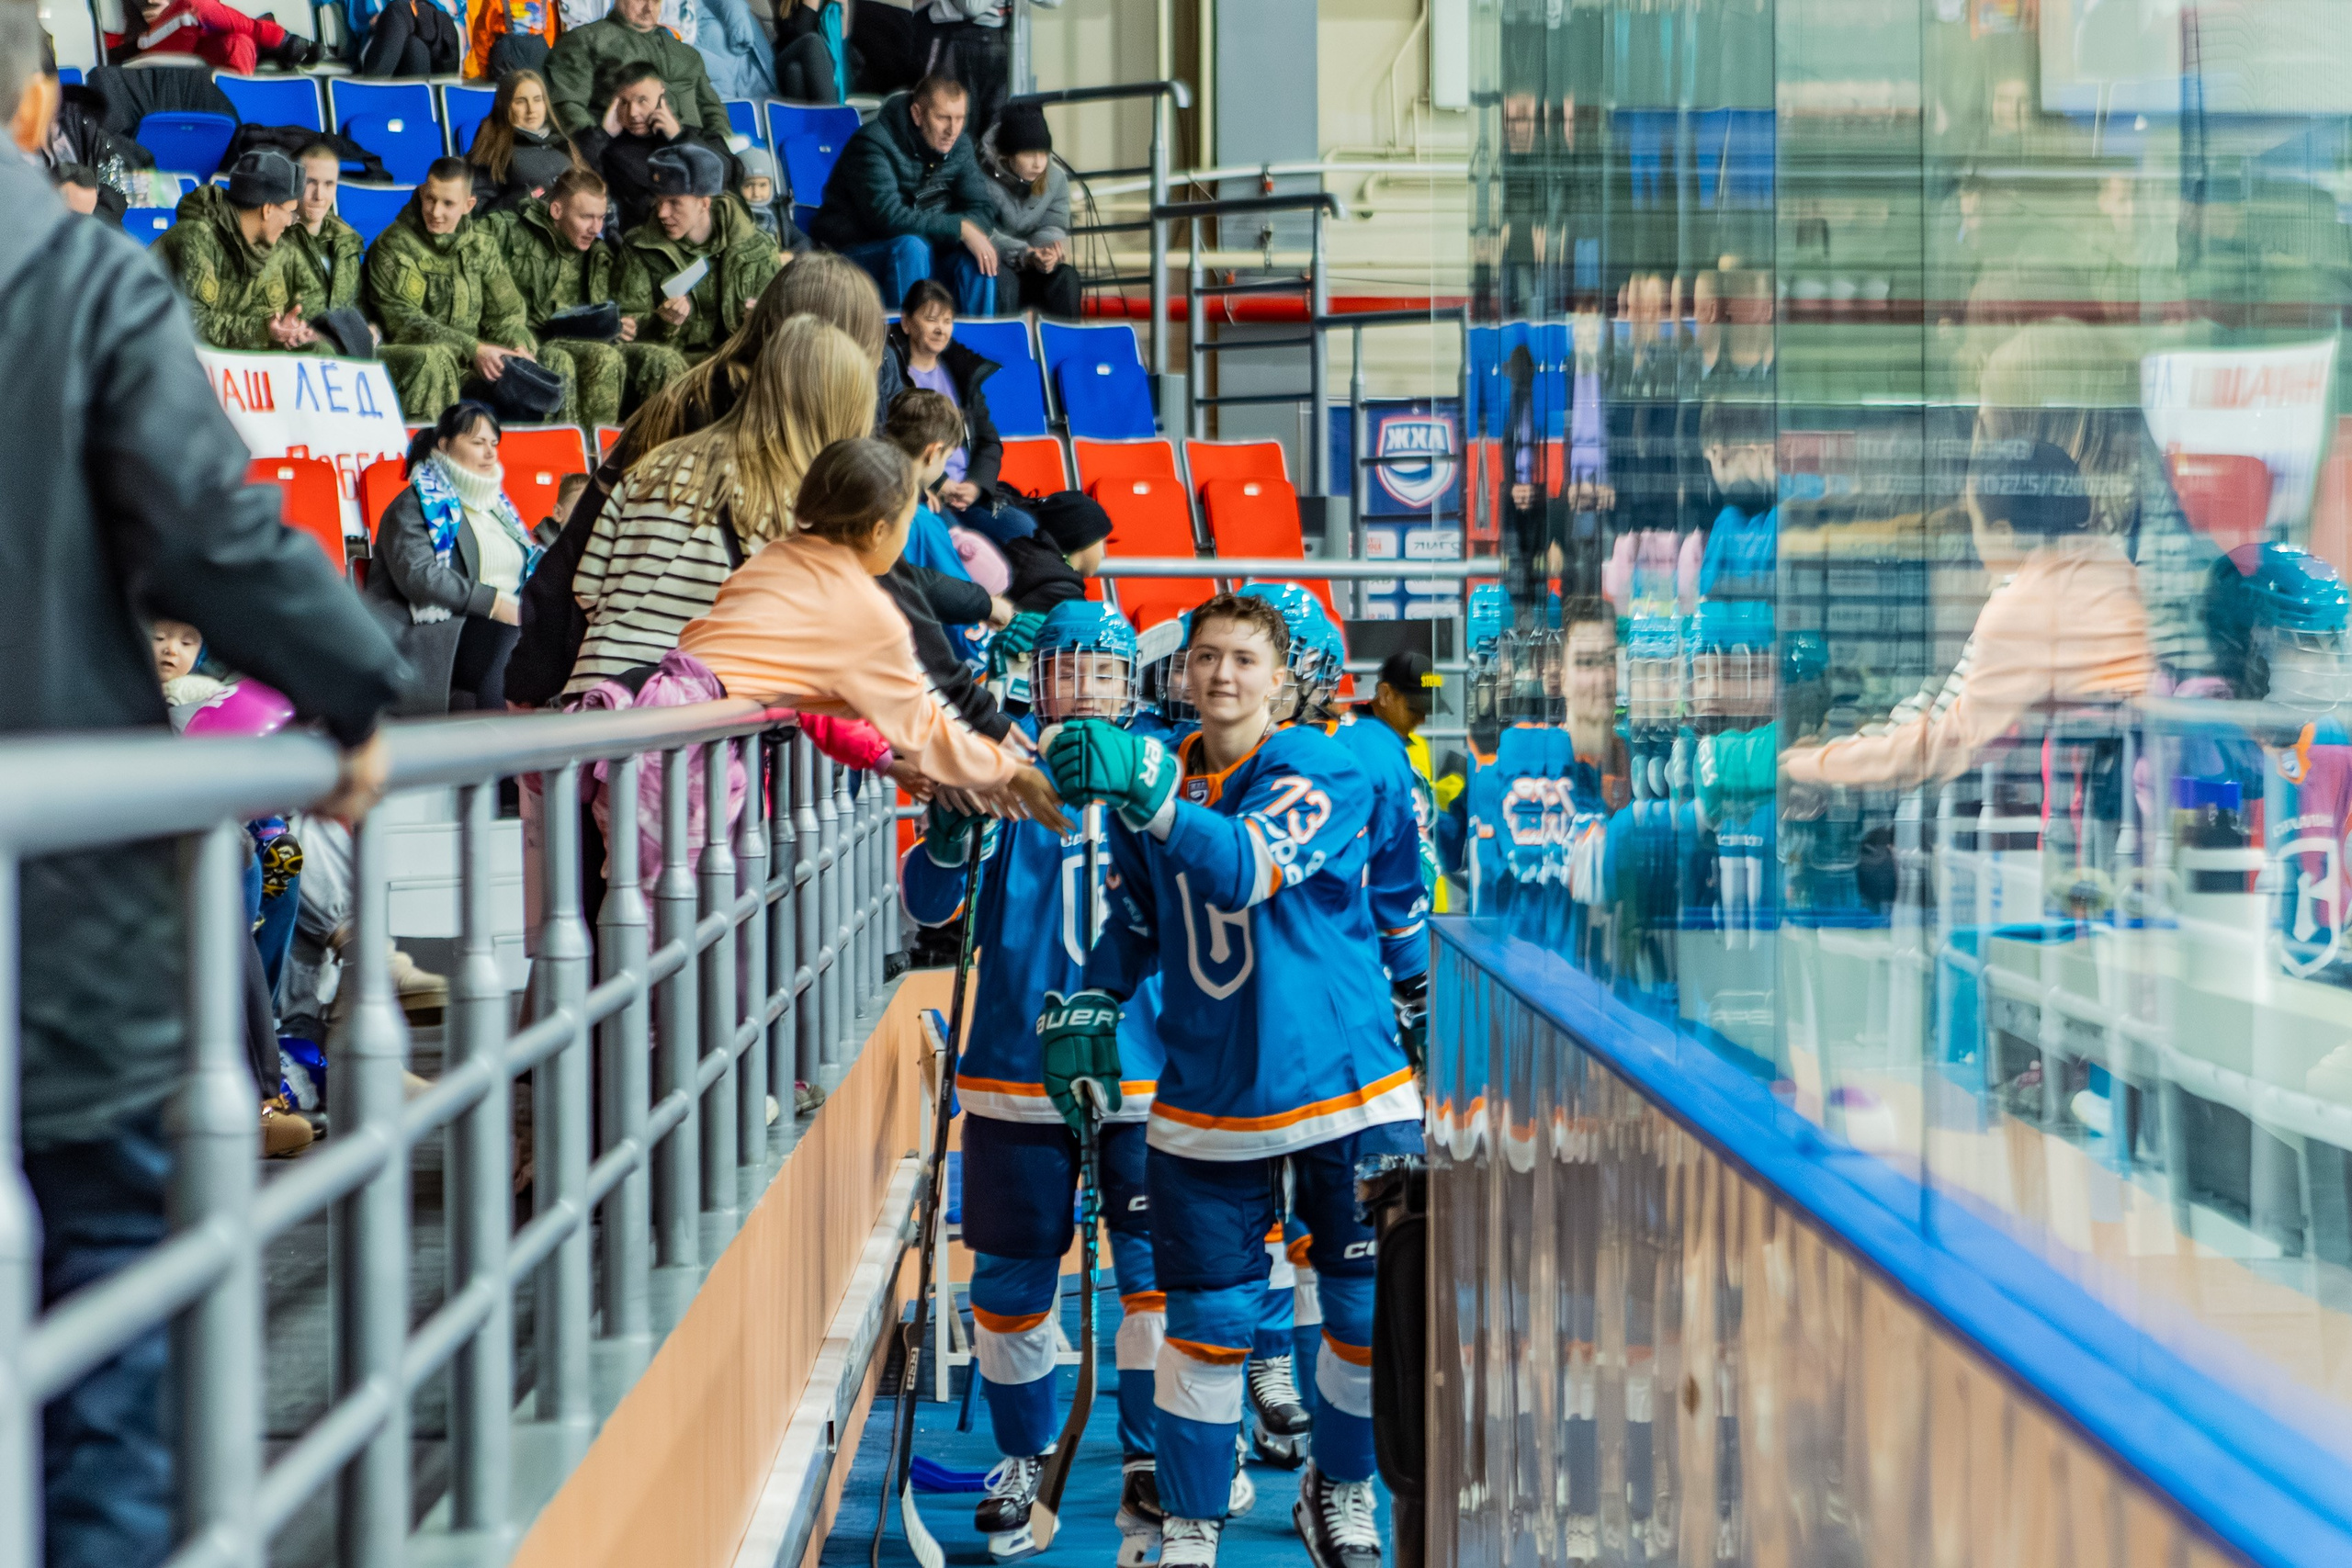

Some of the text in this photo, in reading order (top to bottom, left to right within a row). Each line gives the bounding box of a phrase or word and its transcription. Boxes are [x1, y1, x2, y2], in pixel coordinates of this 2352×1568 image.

[209, 361, 384, 419] АШ ЛЁД
[1385, 427, 1447, 450] ЖХЛ
[1261, 775, 1332, 846] 73
[1035, 1009, 1115, 1036] AUER
